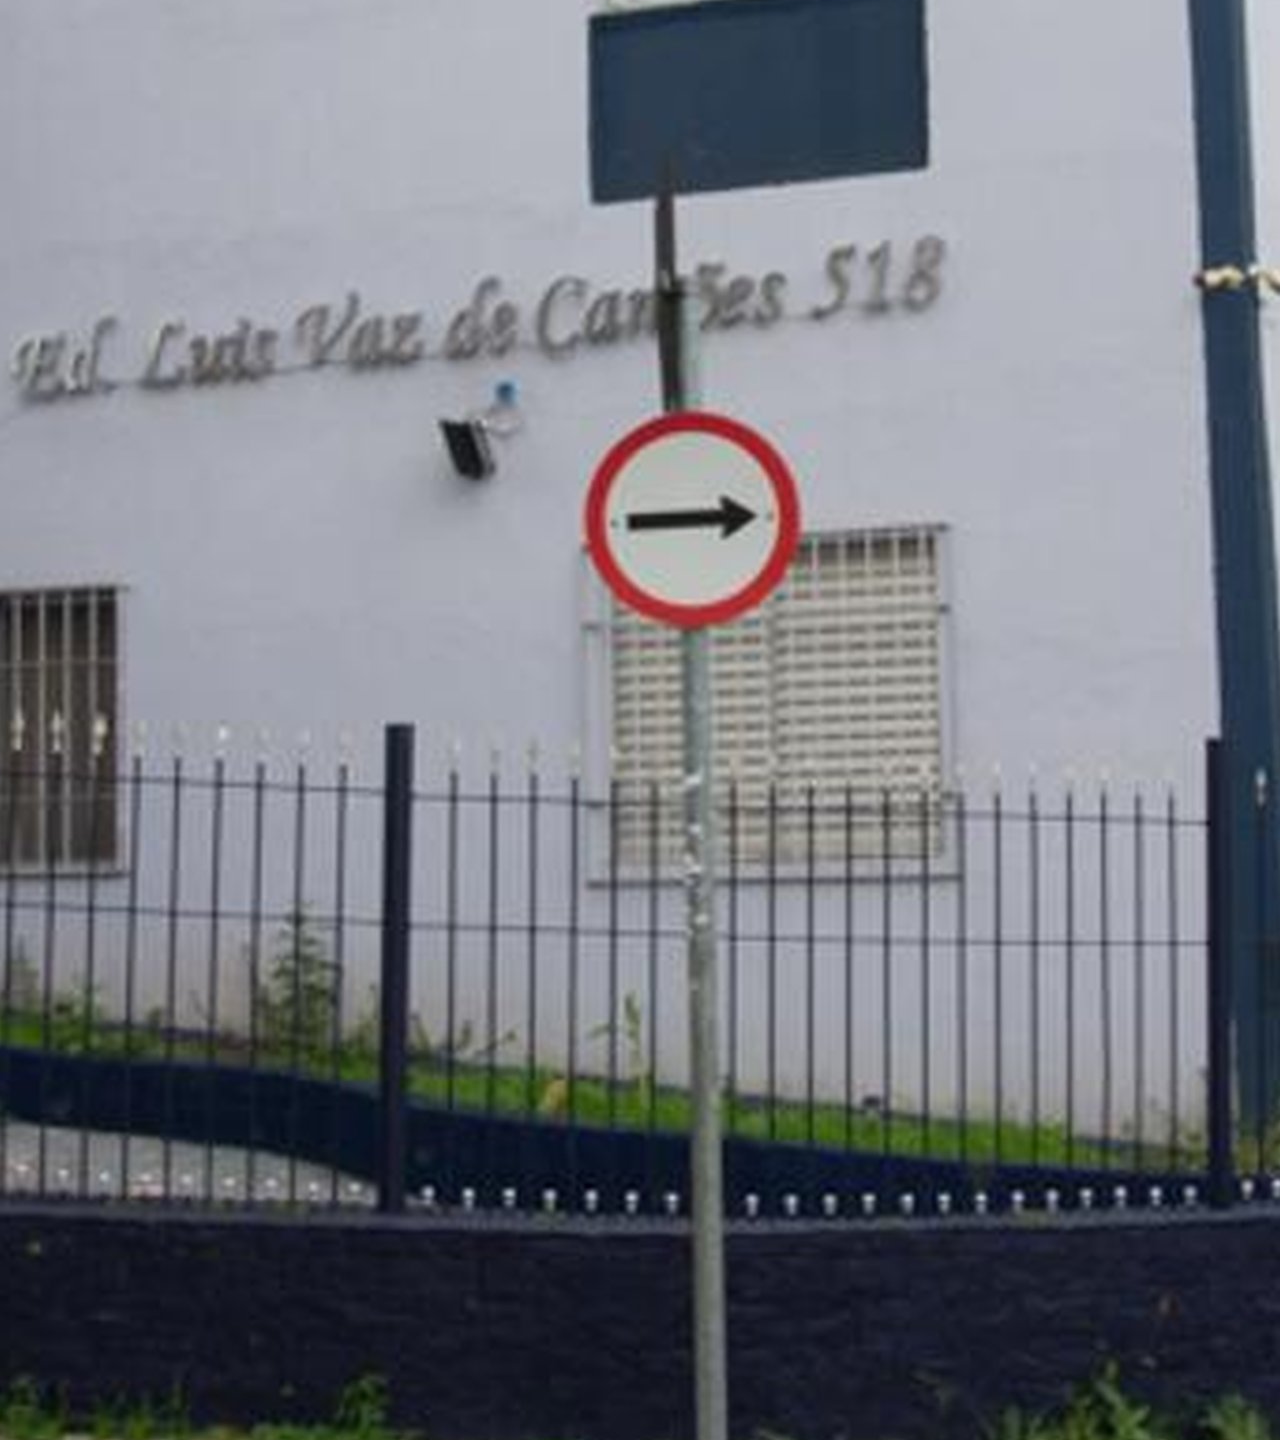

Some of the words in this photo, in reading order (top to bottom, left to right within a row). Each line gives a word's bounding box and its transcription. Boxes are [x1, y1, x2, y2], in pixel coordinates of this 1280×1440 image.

[297, 289, 424, 372] Vaz
[443, 275, 518, 362] de
[812, 233, 946, 322] 518
